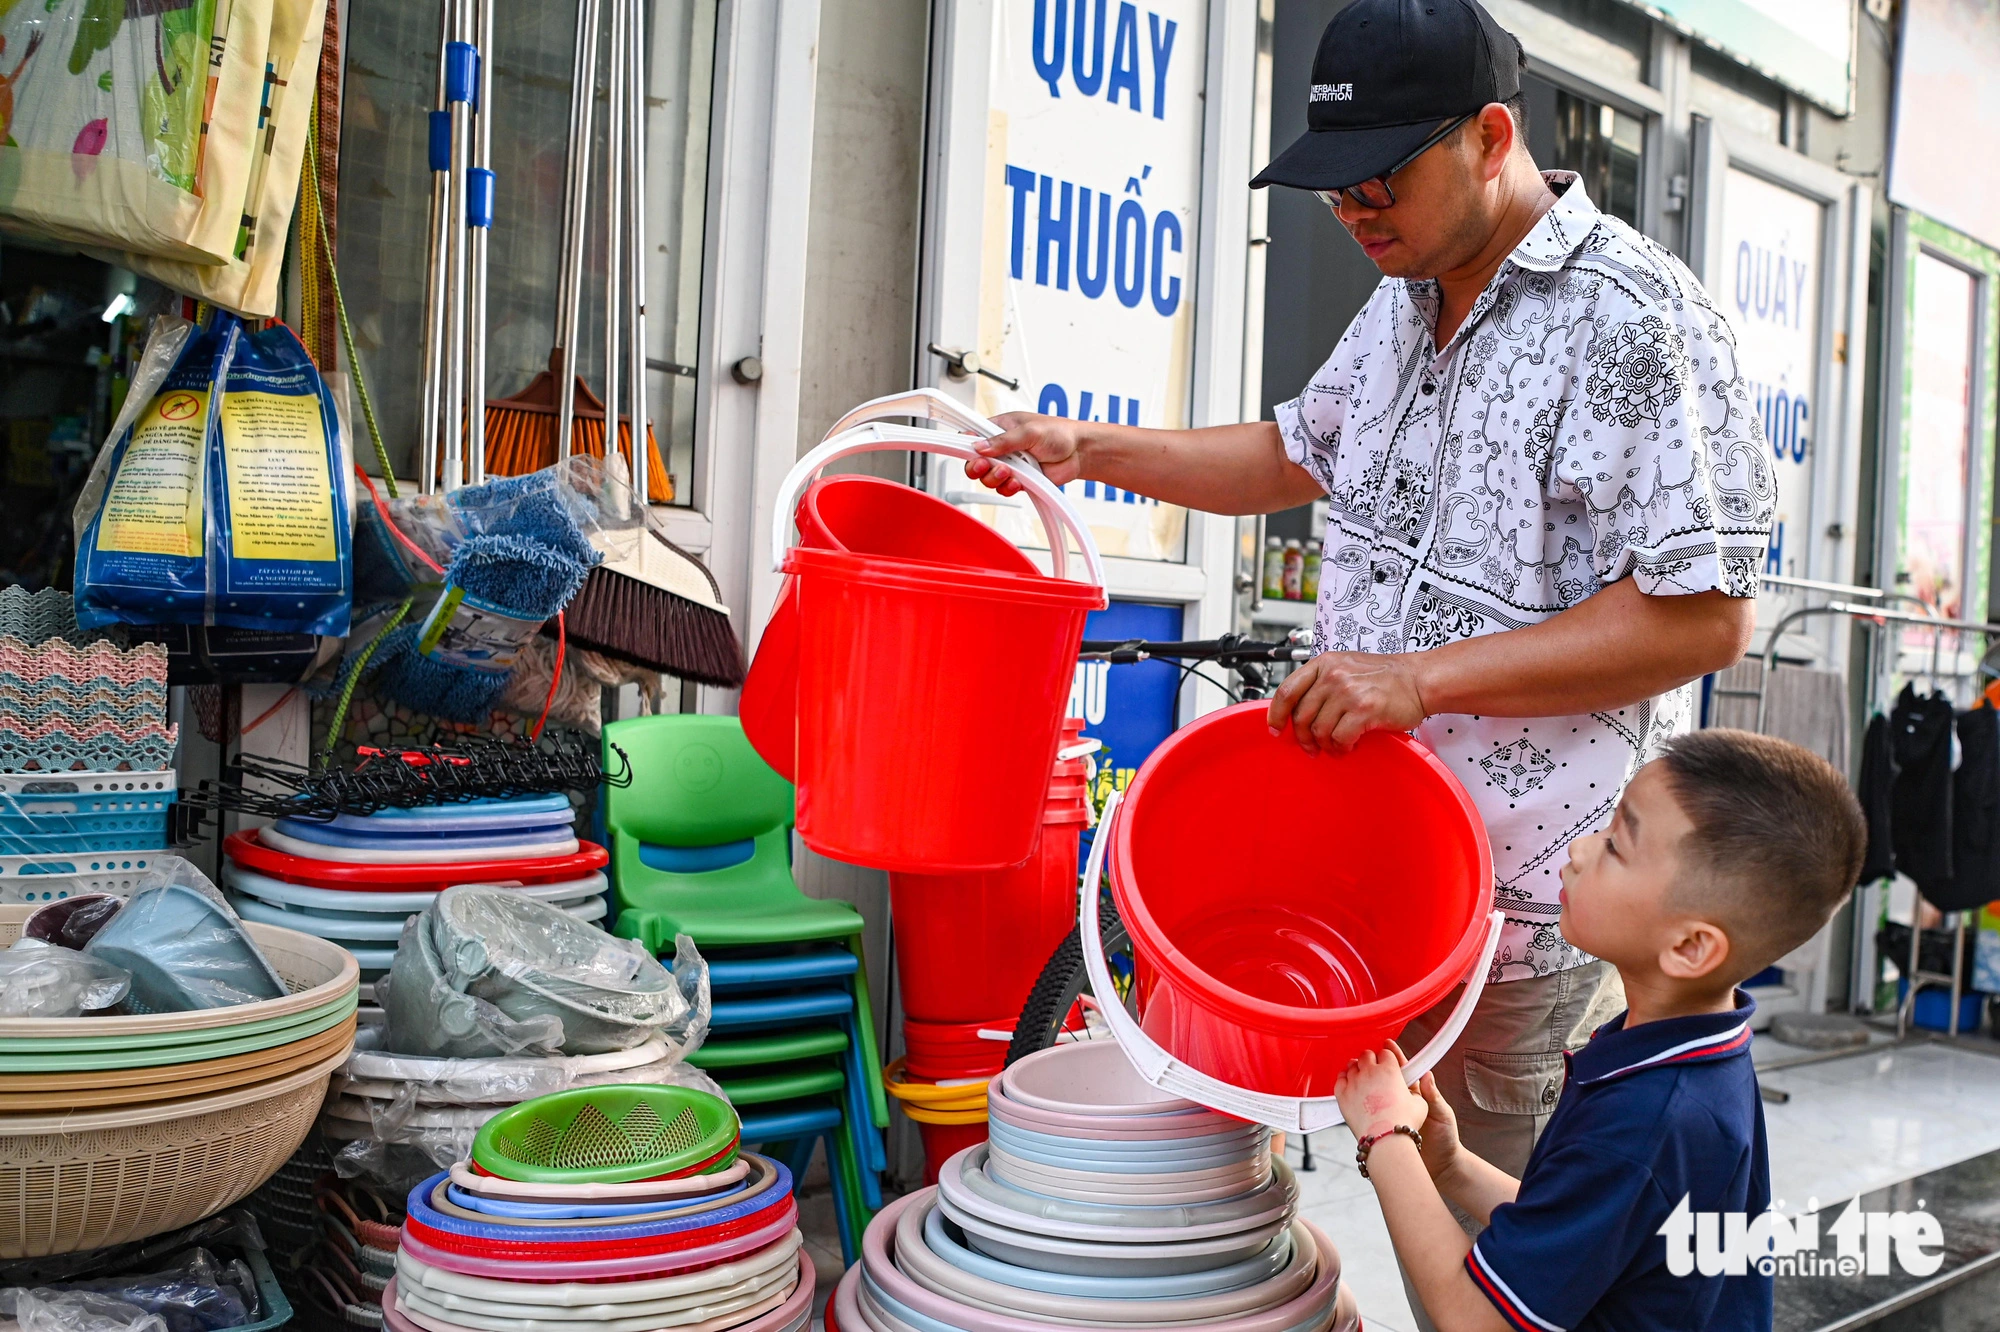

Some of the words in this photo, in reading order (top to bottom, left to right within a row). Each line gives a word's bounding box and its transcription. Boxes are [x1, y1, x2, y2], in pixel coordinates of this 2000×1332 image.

[1311, 84, 1353, 94] HERBALIFE
[1310, 92, 1352, 102] NUTRITION
[1005, 165, 1183, 317] THUỐC
